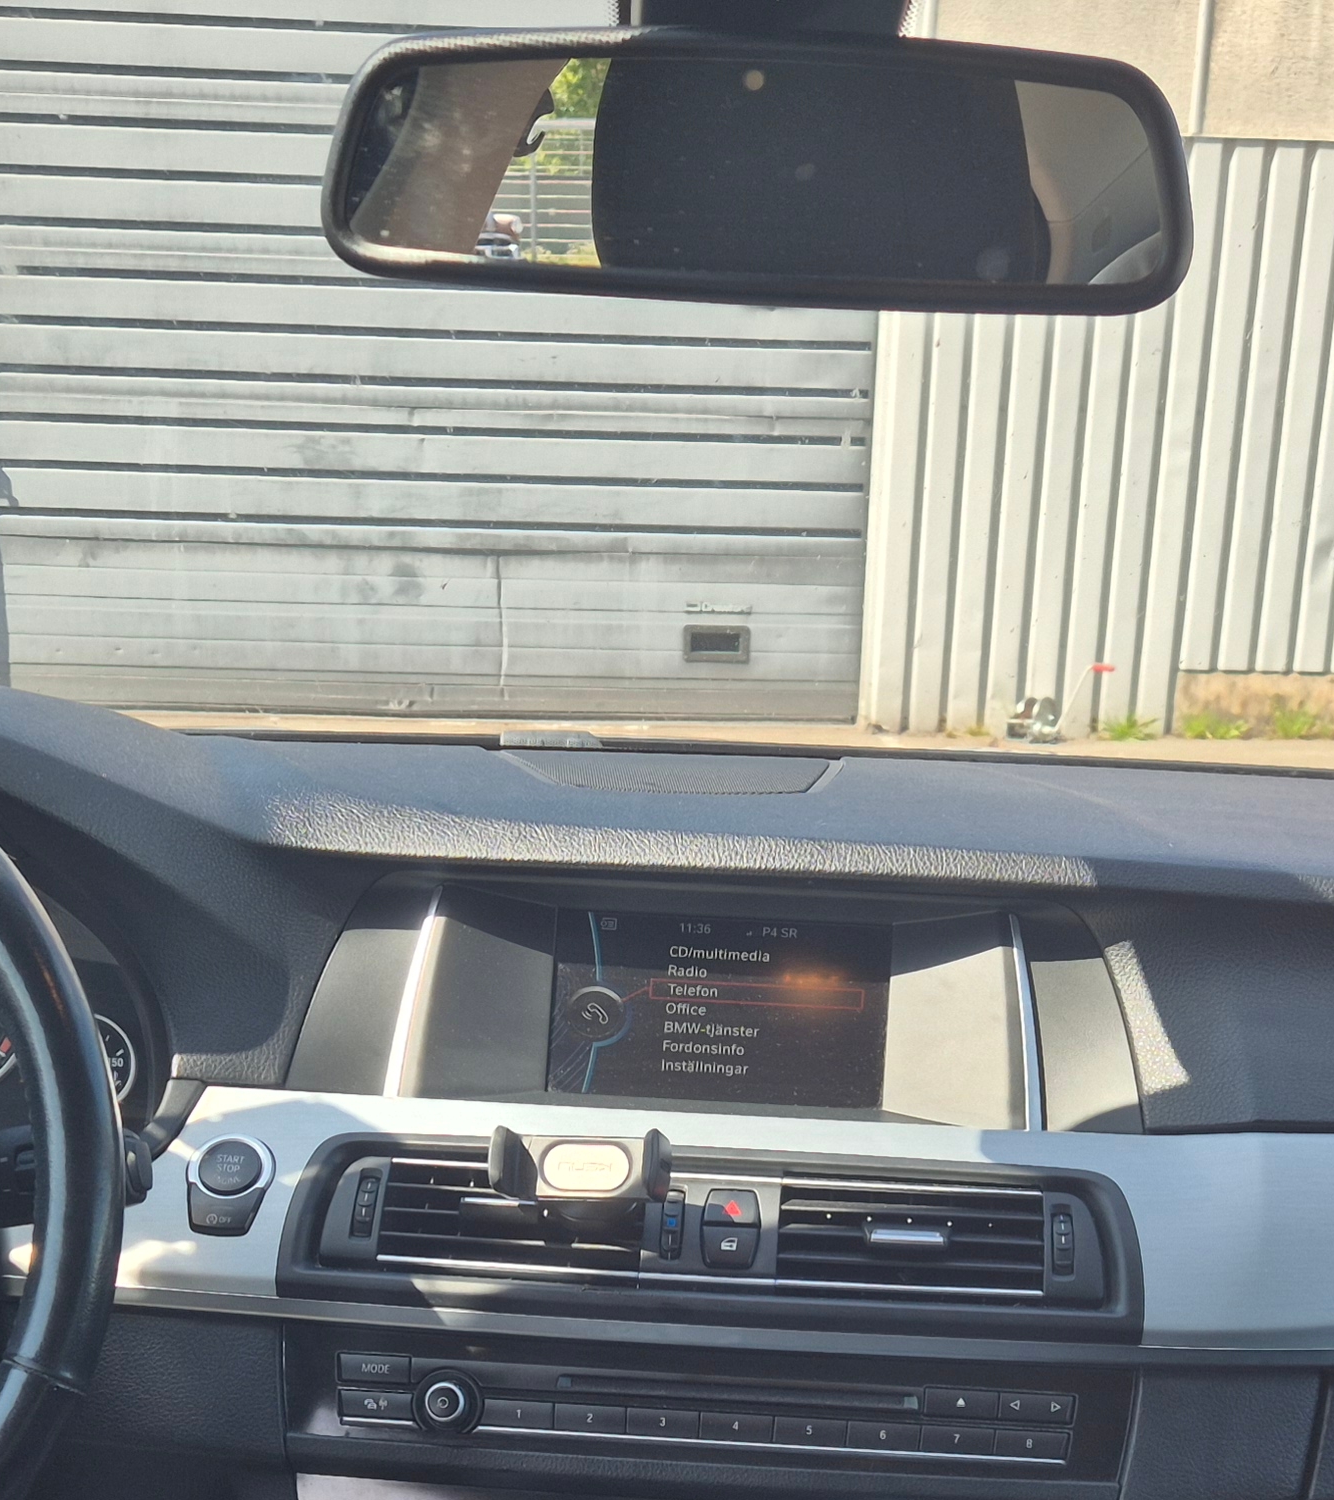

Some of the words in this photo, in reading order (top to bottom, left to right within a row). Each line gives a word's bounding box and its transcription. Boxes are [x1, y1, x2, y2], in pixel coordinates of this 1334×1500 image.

[679, 922, 711, 934] 11:36
[762, 927, 777, 938] P4
[780, 928, 798, 938] SR
[669, 945, 770, 962] CD/multimedia
[667, 964, 708, 978] Radio
[667, 983, 718, 997] Telefon
[665, 1002, 707, 1016] Office
[663, 1021, 760, 1038] BMW-tjänster
[662, 1039, 745, 1056] Fordonsinfo
[661, 1058, 749, 1077] Inställningar
[217, 1154, 245, 1164] START
[217, 1163, 240, 1173] STOP
[361, 1362, 390, 1375] MODE
[516, 1408, 522, 1419] 1
[586, 1412, 594, 1423] 2
[659, 1417, 666, 1427] 3
[732, 1420, 740, 1431] 4
[805, 1425, 813, 1436] 5
[879, 1430, 887, 1440] 6
[953, 1433, 961, 1444] 7
[1025, 1438, 1033, 1449] 8
